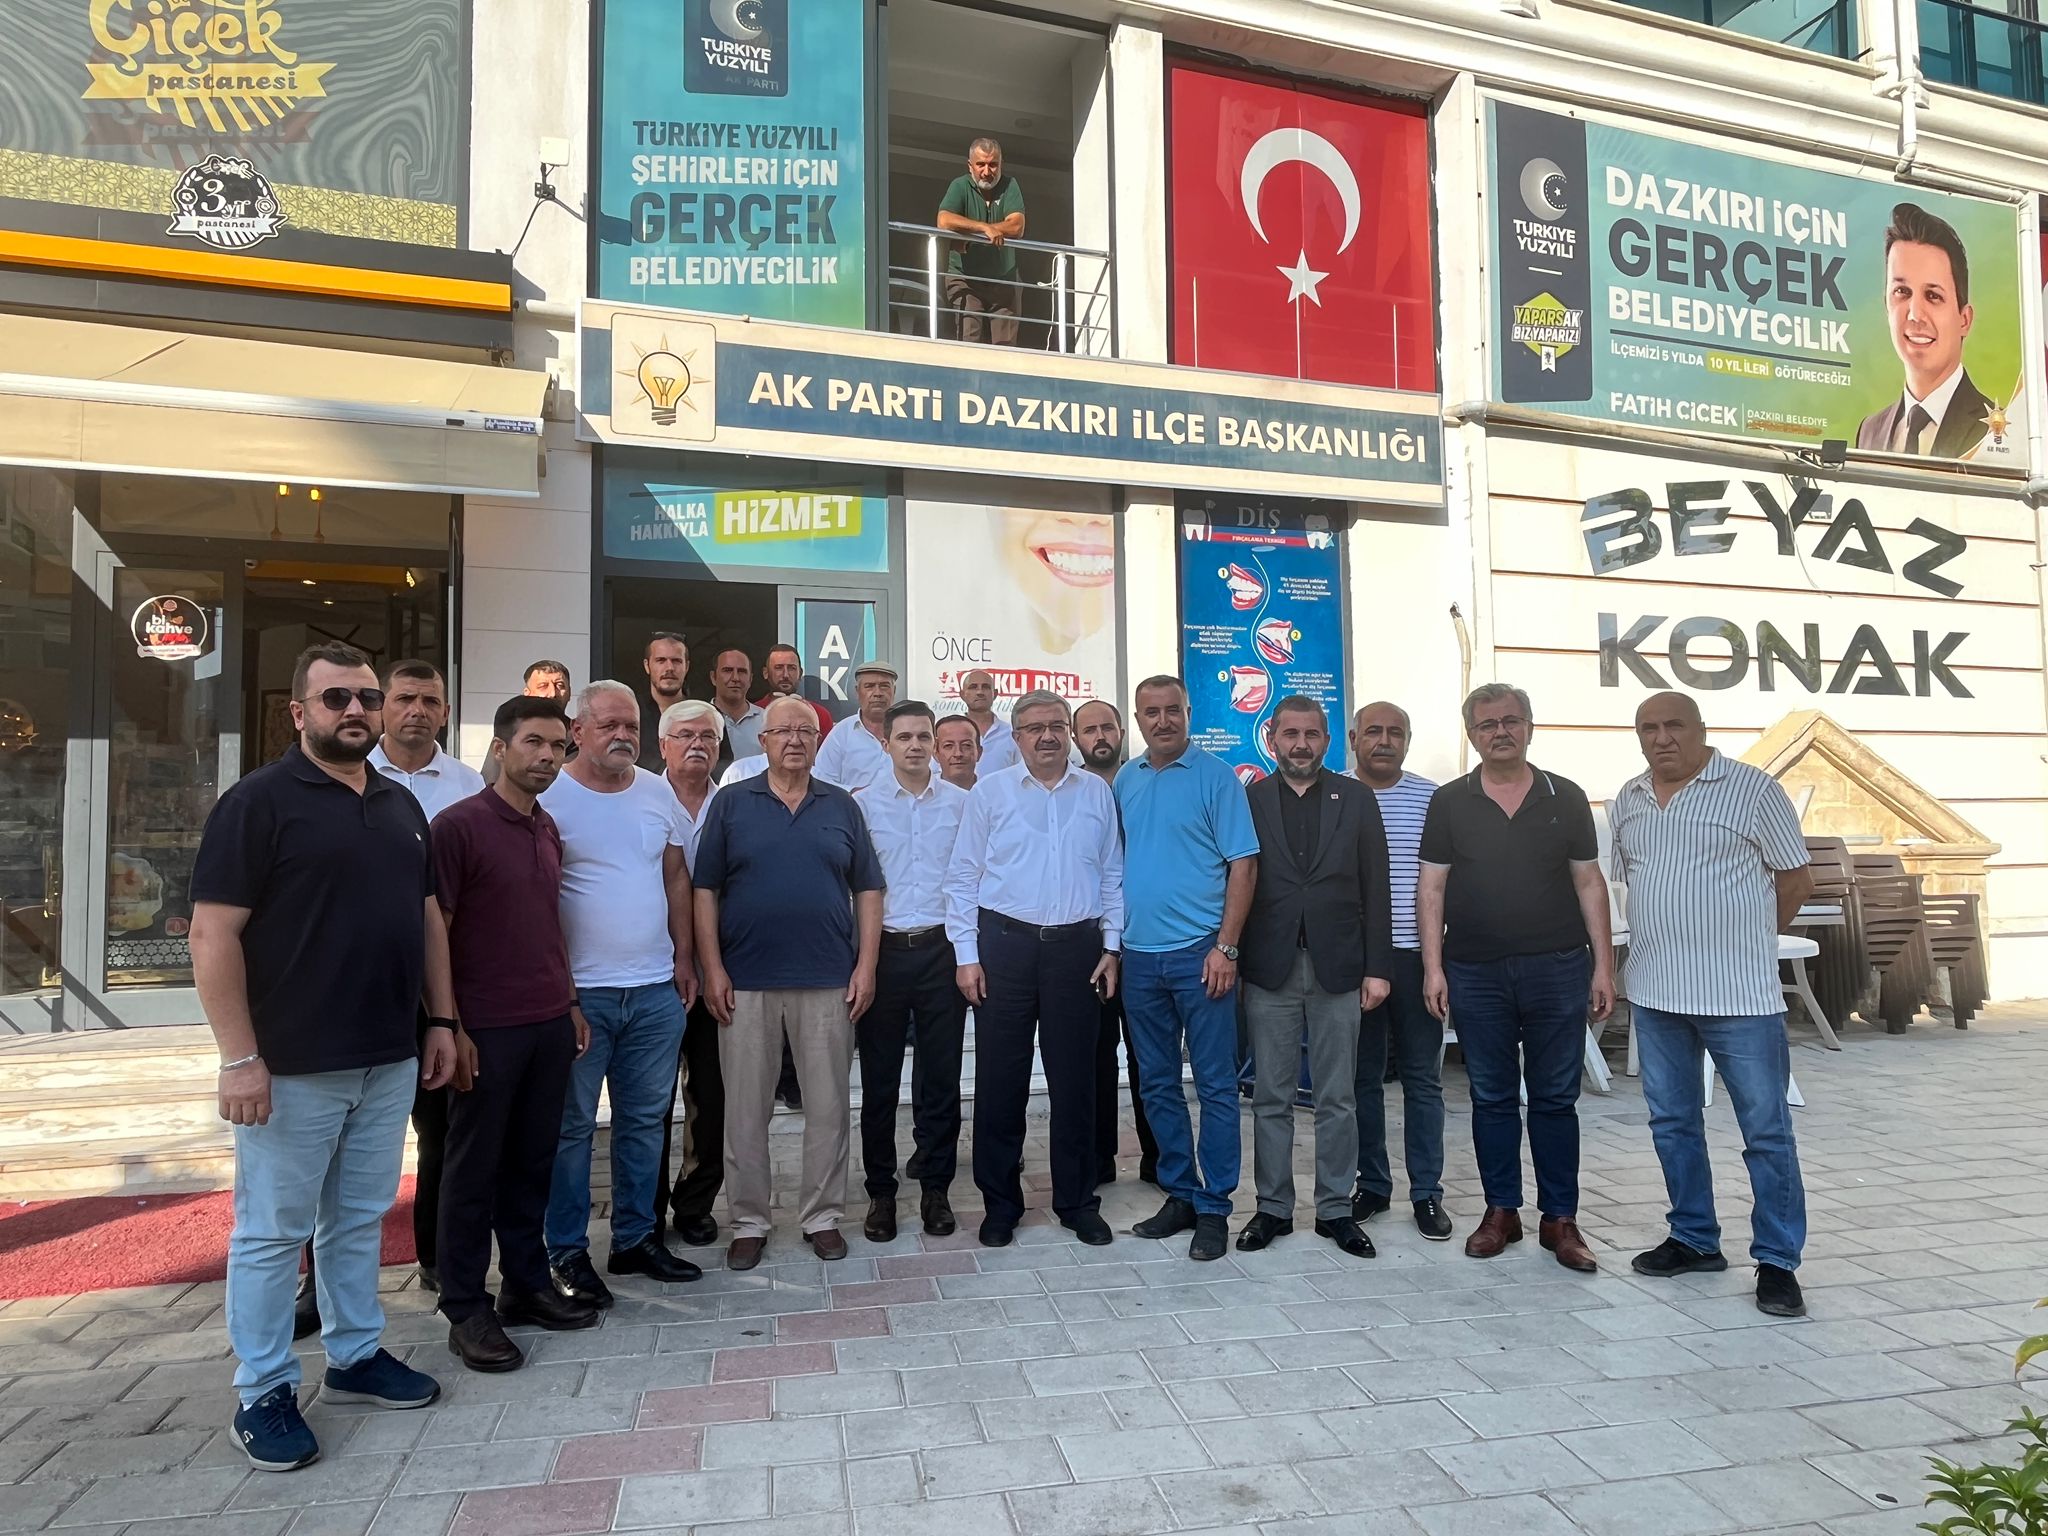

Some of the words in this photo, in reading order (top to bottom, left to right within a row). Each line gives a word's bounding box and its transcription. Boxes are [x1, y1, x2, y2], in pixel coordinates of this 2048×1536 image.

[147, 71, 298, 96] pastanesi
[632, 155, 778, 185] ŞEHİRLERİ
[783, 158, 838, 188] İÇİN
[201, 179, 227, 213] 3
[1606, 165, 1765, 233] DAZKIRI
[1773, 200, 1847, 248] İÇİN
[630, 192, 837, 251] GERÇEK
[630, 256, 838, 285] BELEDİYECİLİK
[1608, 217, 1848, 312] GERÇEK
[1516, 307, 1580, 328] YAPARSAK
[1608, 285, 1851, 354] BELEDİYECİLİK
[1662, 352, 1669, 361] 5
[1671, 352, 1704, 367] YILDA
[1710, 357, 1723, 369] 10
[1725, 359, 1742, 372] YIL
[748, 371, 814, 409] AK
[958, 393, 1118, 437] DAZKIRI
[1218, 416, 1426, 463] BAŞKANLIĞI
[1747, 409, 1784, 422] DAZKIRI
[654, 502, 707, 521] HALKA
[630, 520, 708, 541] HAKKIYLA
[1580, 480, 1967, 599] BEYAZ
[145, 622, 194, 634] kahve
[932, 631, 992, 662] ÖNCE
[1597, 612, 1975, 698] KONAK
